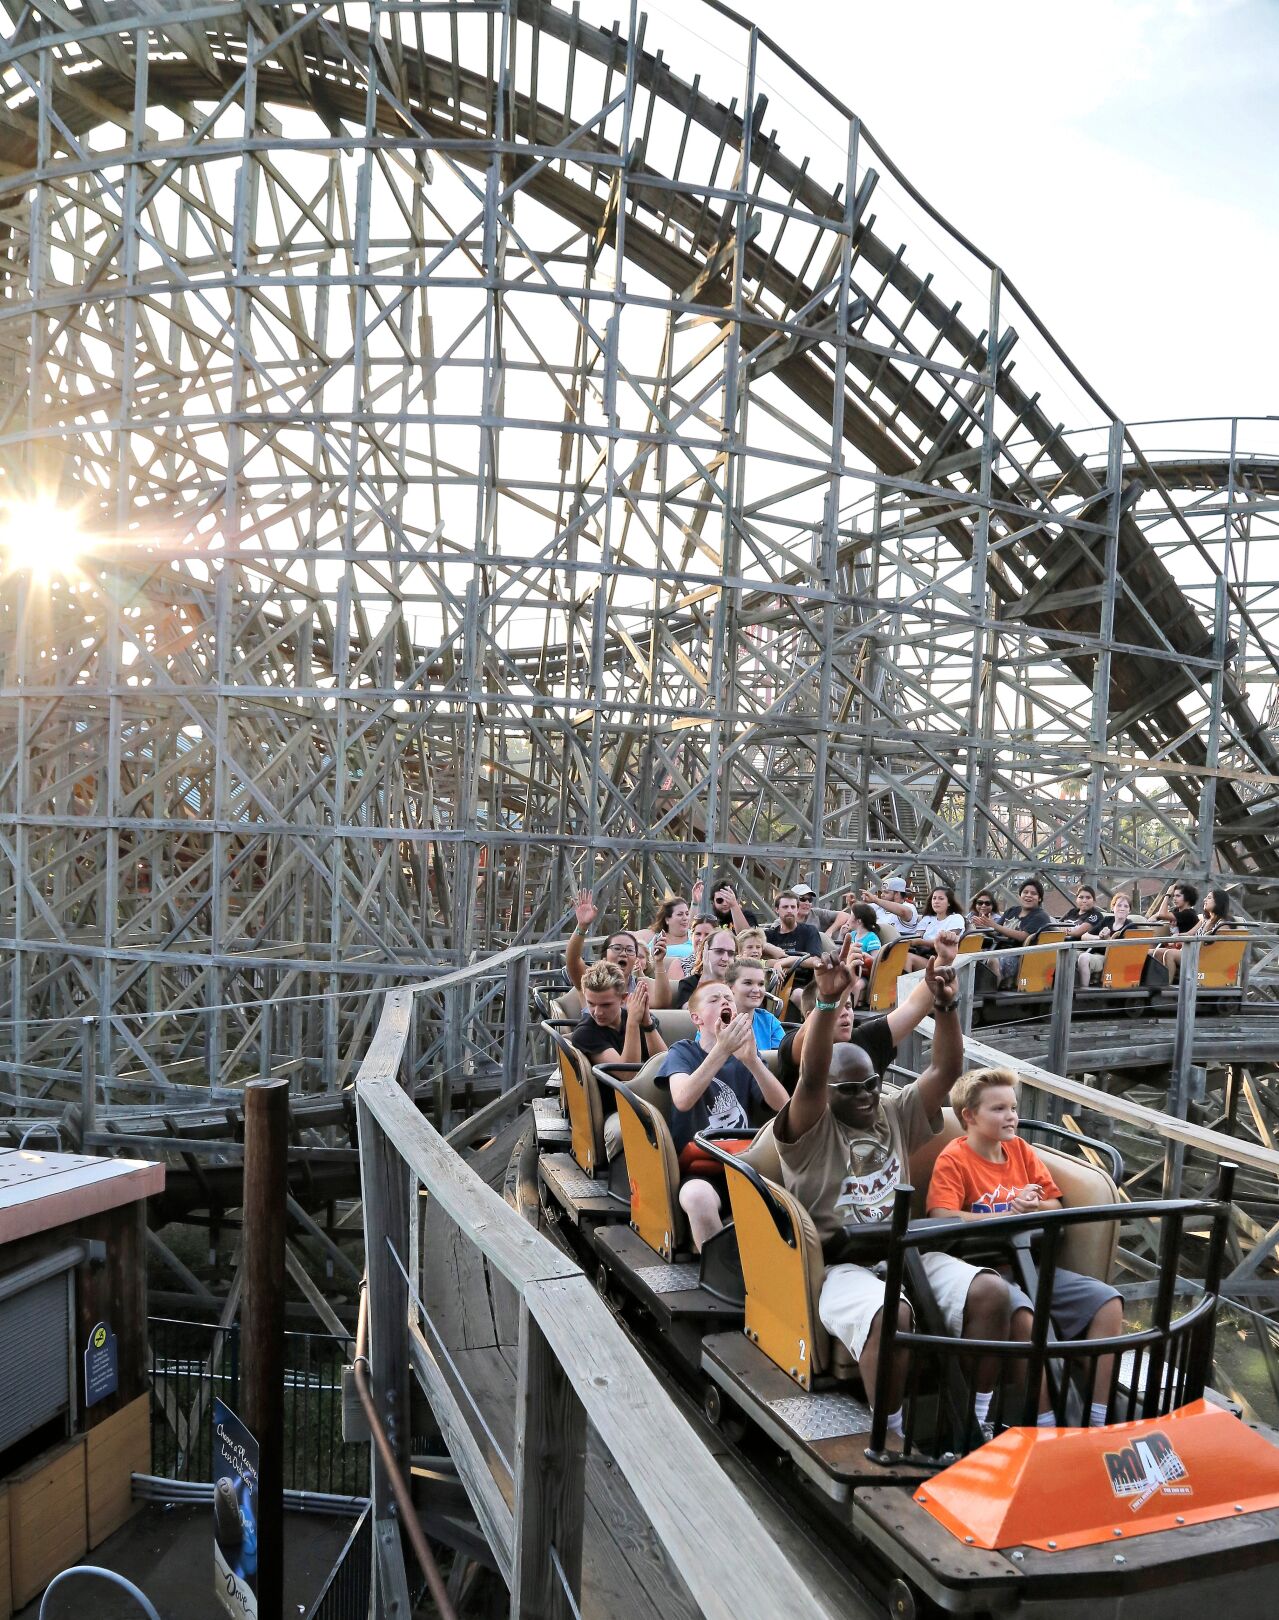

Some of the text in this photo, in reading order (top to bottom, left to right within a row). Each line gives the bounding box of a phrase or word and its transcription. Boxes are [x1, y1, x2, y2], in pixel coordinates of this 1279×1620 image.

[842, 1157, 900, 1196] ROAR
[799, 1338, 806, 1361] 2
[216, 1423, 234, 1448] Choose
[237, 1444, 257, 1478] Pleasure
[221, 1443, 253, 1496] Less Ordinary
[1104, 1432, 1185, 1493] ROAR
[225, 1573, 248, 1611] Dove
